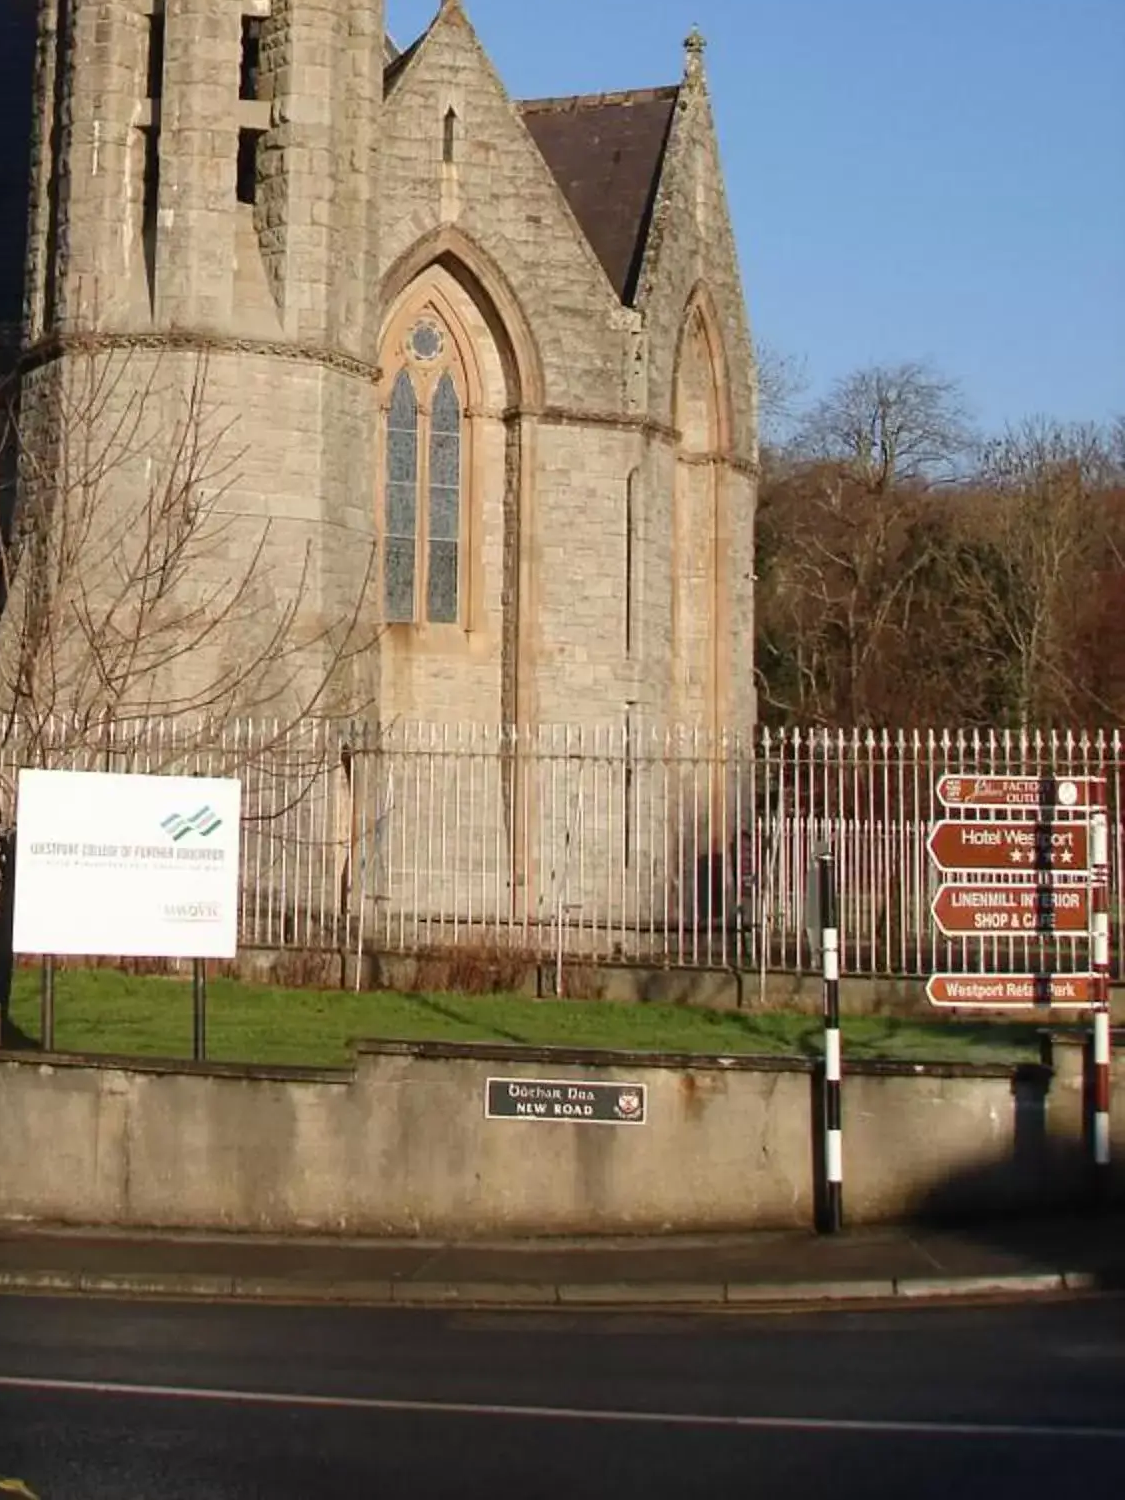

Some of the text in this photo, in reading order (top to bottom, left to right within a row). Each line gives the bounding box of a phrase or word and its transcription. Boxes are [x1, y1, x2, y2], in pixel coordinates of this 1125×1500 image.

[961, 829, 1000, 845] Hotel
[951, 891, 1019, 907] LINENMILL
[974, 912, 1008, 928] SHOP
[1010, 912, 1020, 928] &
[946, 982, 1004, 1000] Westport
[516, 1102, 593, 1116] NEW ROAD
